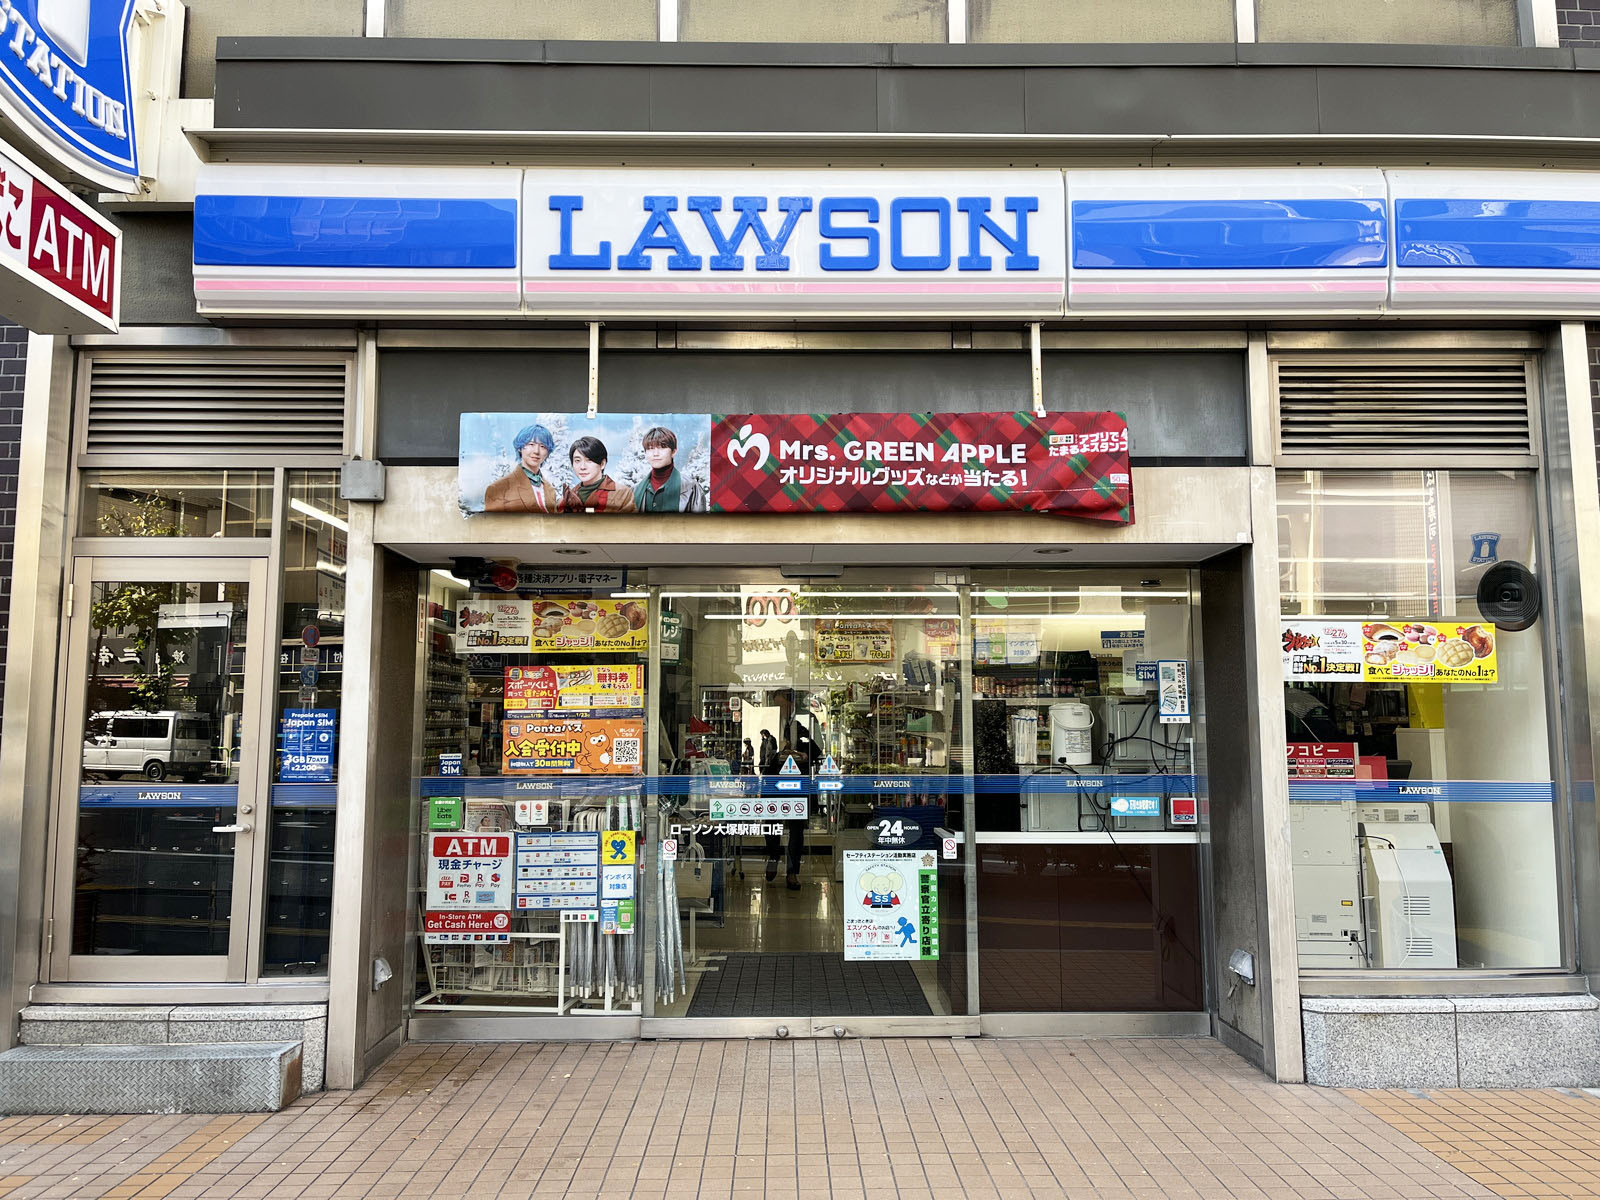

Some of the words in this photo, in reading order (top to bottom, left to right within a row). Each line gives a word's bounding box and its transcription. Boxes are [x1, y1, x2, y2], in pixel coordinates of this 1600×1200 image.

[548, 196, 1039, 271] LAWSON
[33, 204, 110, 303] ATM
[779, 440, 836, 460] Mrs.
[843, 441, 935, 462] GREEN
[941, 442, 1027, 463] APPLE
[779, 466, 1028, 487] オリジナルグッズなどが当たる!
[286, 719, 315, 727] Japan
[526, 724, 583, 733] Pontaパス
[504, 739, 581, 757] 入会受付中
[442, 766, 460, 774] SIM
[138, 792, 181, 800] LAWSON
[670, 823, 784, 836] ローソン大塚駅南口店
[879, 820, 904, 837] 24
[446, 838, 497, 856] ATM
[438, 859, 502, 870] 現金チャージ
[428, 920, 442, 928] Get
[445, 920, 466, 928] Cash
[468, 920, 493, 928] Here!
